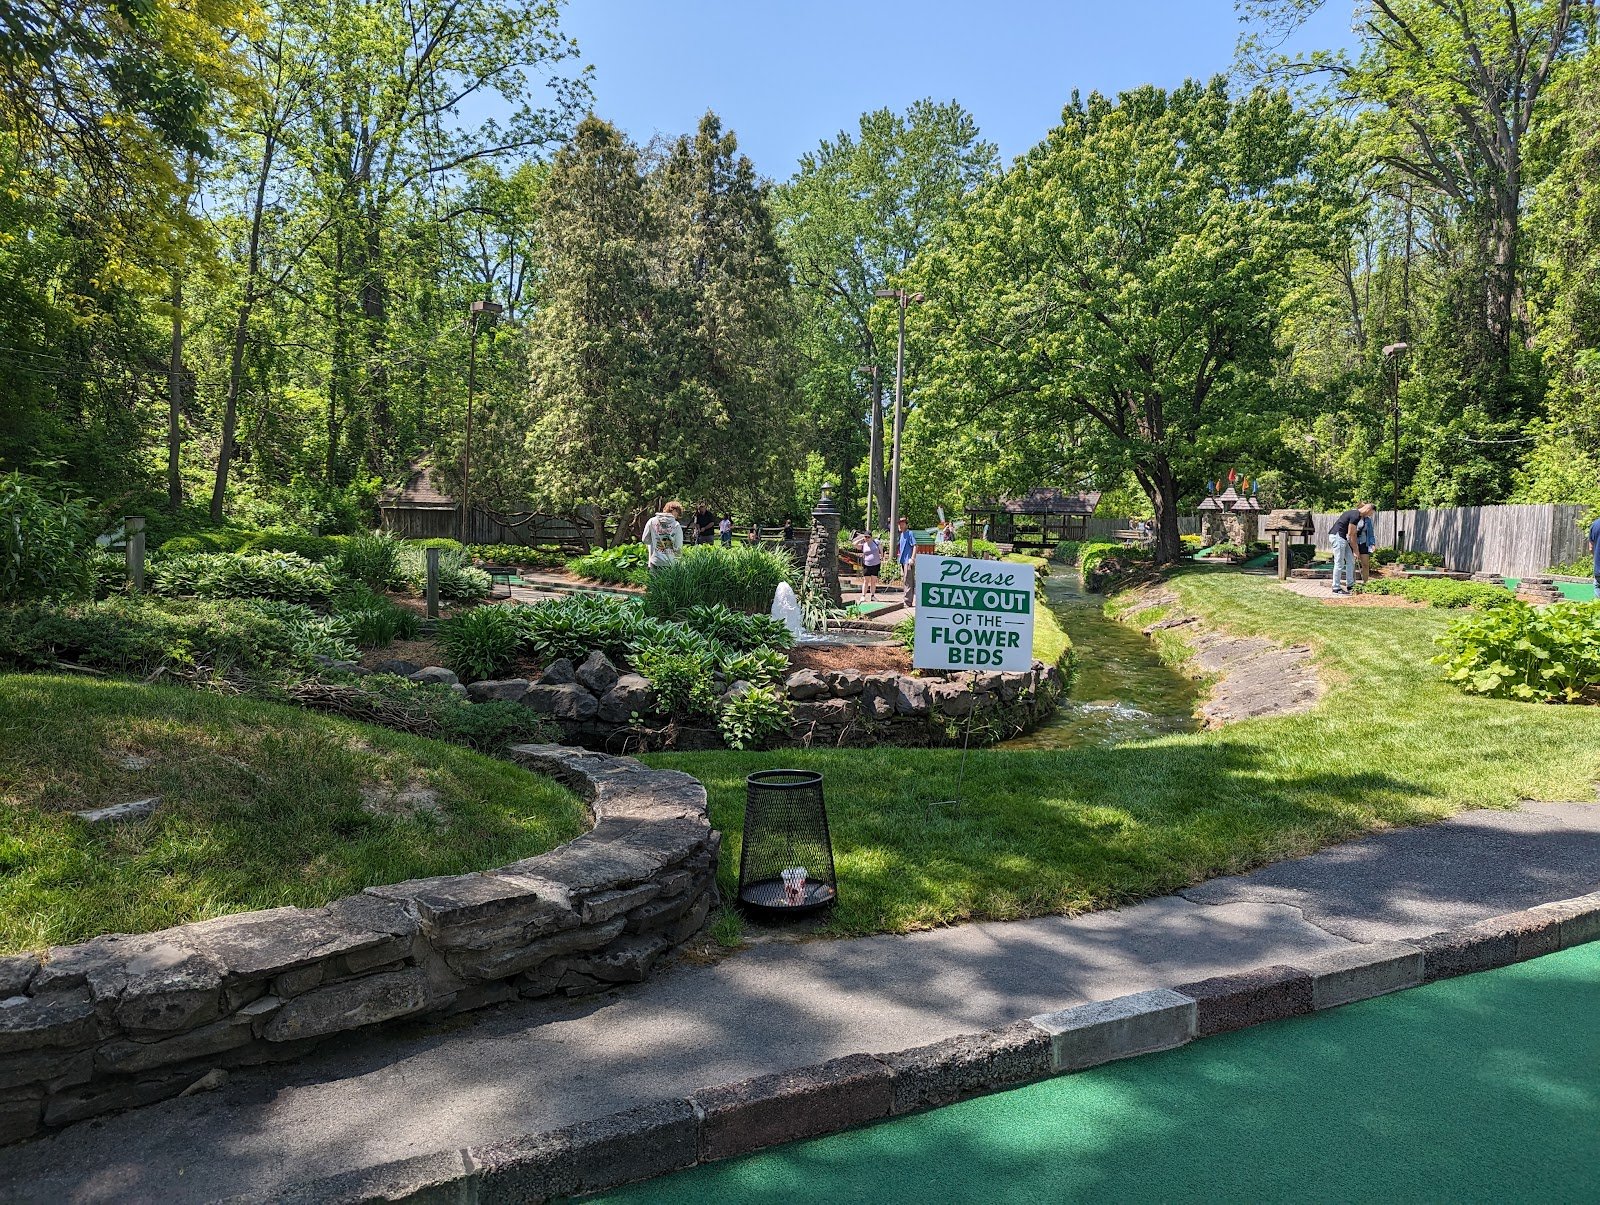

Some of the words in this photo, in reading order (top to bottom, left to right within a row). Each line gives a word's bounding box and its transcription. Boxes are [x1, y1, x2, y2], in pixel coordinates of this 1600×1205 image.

[940, 560, 1015, 586] Please
[928, 587, 978, 607] STAY
[983, 592, 1026, 610] OUT
[952, 613, 972, 625] OF
[977, 615, 1002, 627] THE
[931, 627, 1020, 648] FLOWER
[948, 647, 1004, 666] BEDS
